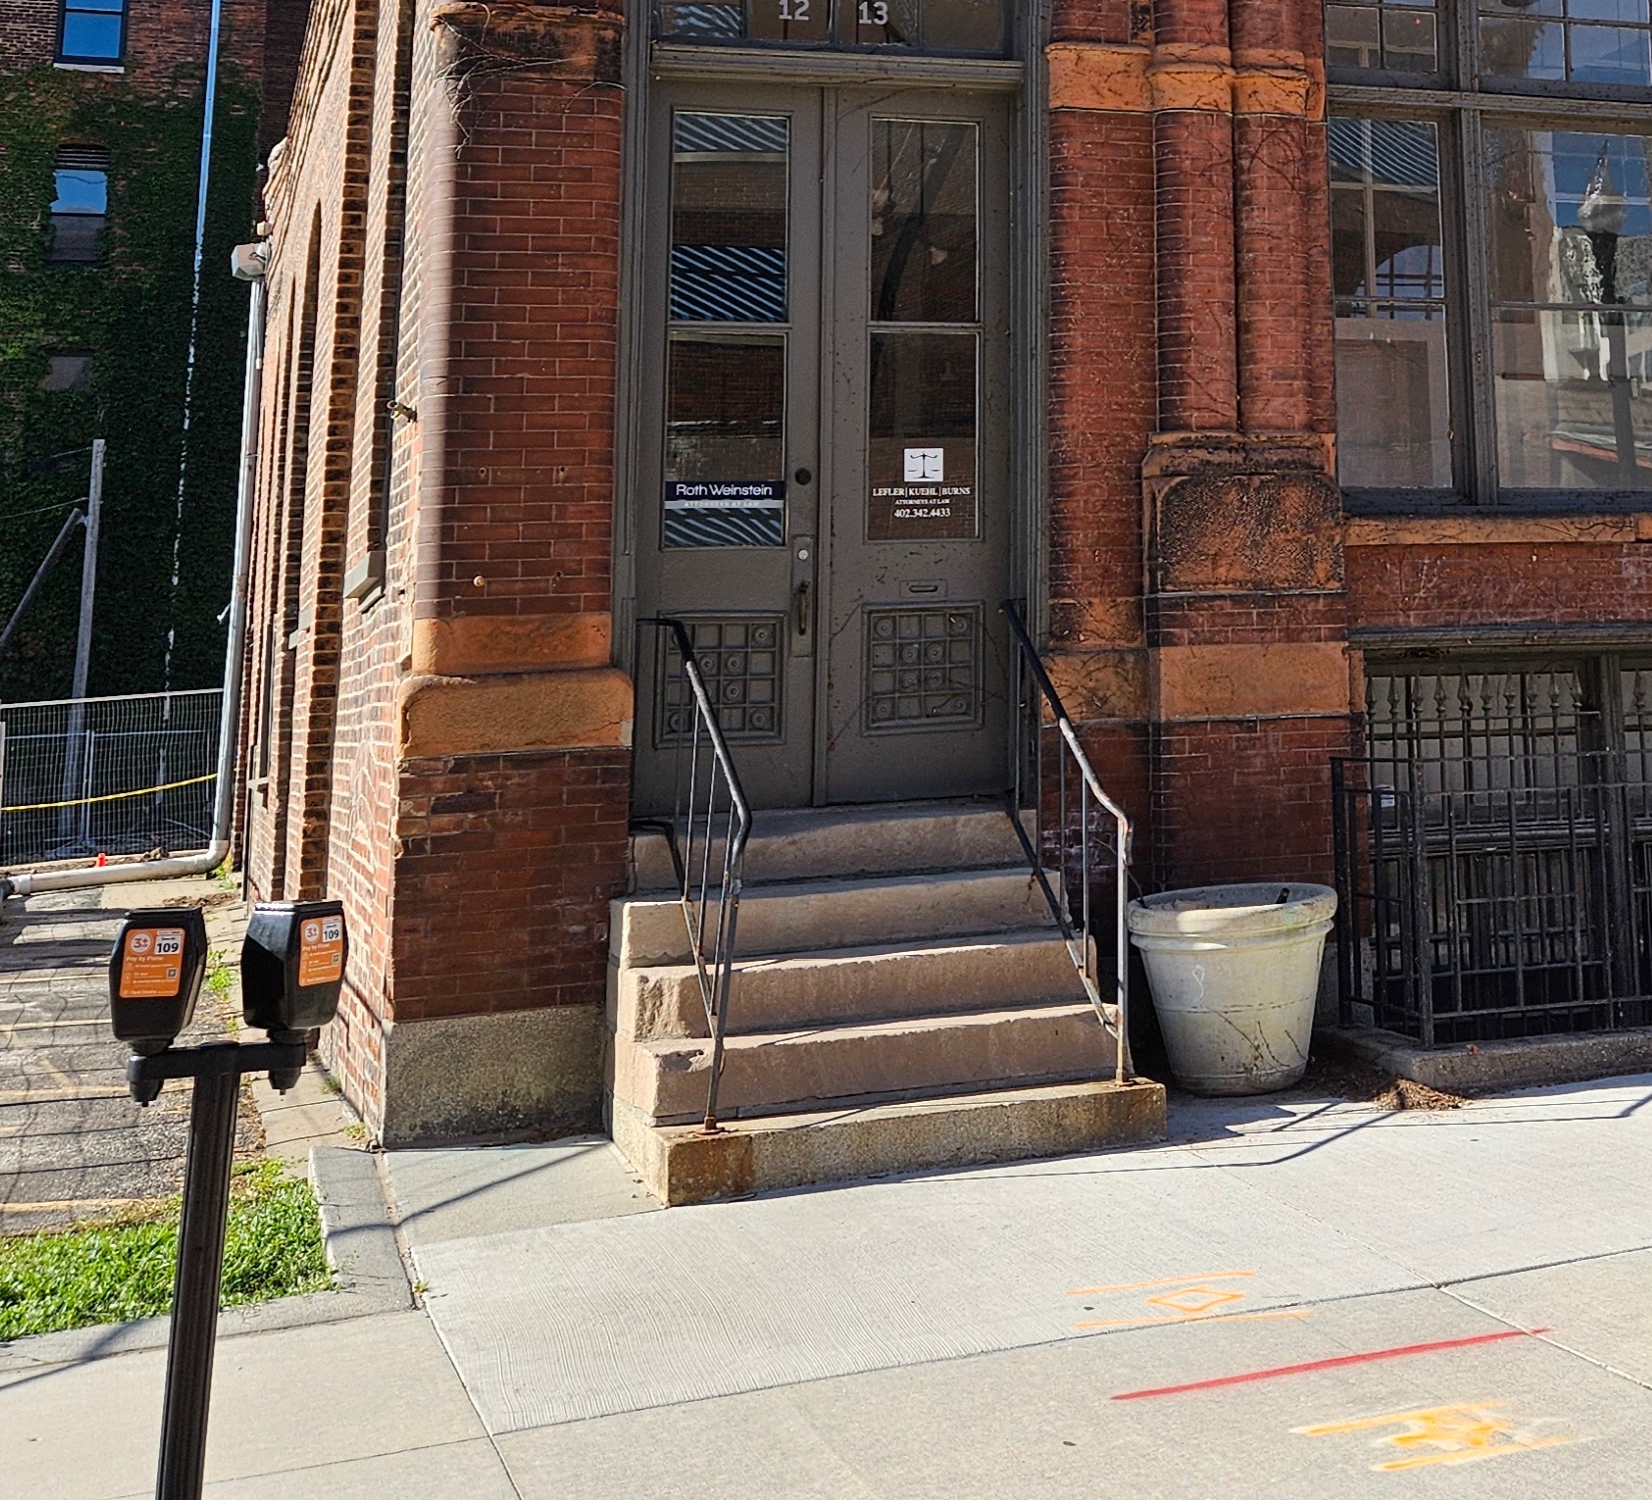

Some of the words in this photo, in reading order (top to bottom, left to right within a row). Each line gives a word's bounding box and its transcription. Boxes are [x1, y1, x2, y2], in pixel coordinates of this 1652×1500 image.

[858, 1, 889, 26] 13
[675, 483, 708, 496] Roth
[709, 483, 773, 496] Weinstein
[872, 488, 905, 497] LEFLER
[909, 487, 938, 496] KUEHL
[942, 487, 971, 496] BURNS
[893, 508, 951, 518] 402.342.4433
[323, 929, 340, 941] 109
[156, 942, 179, 953] 109
